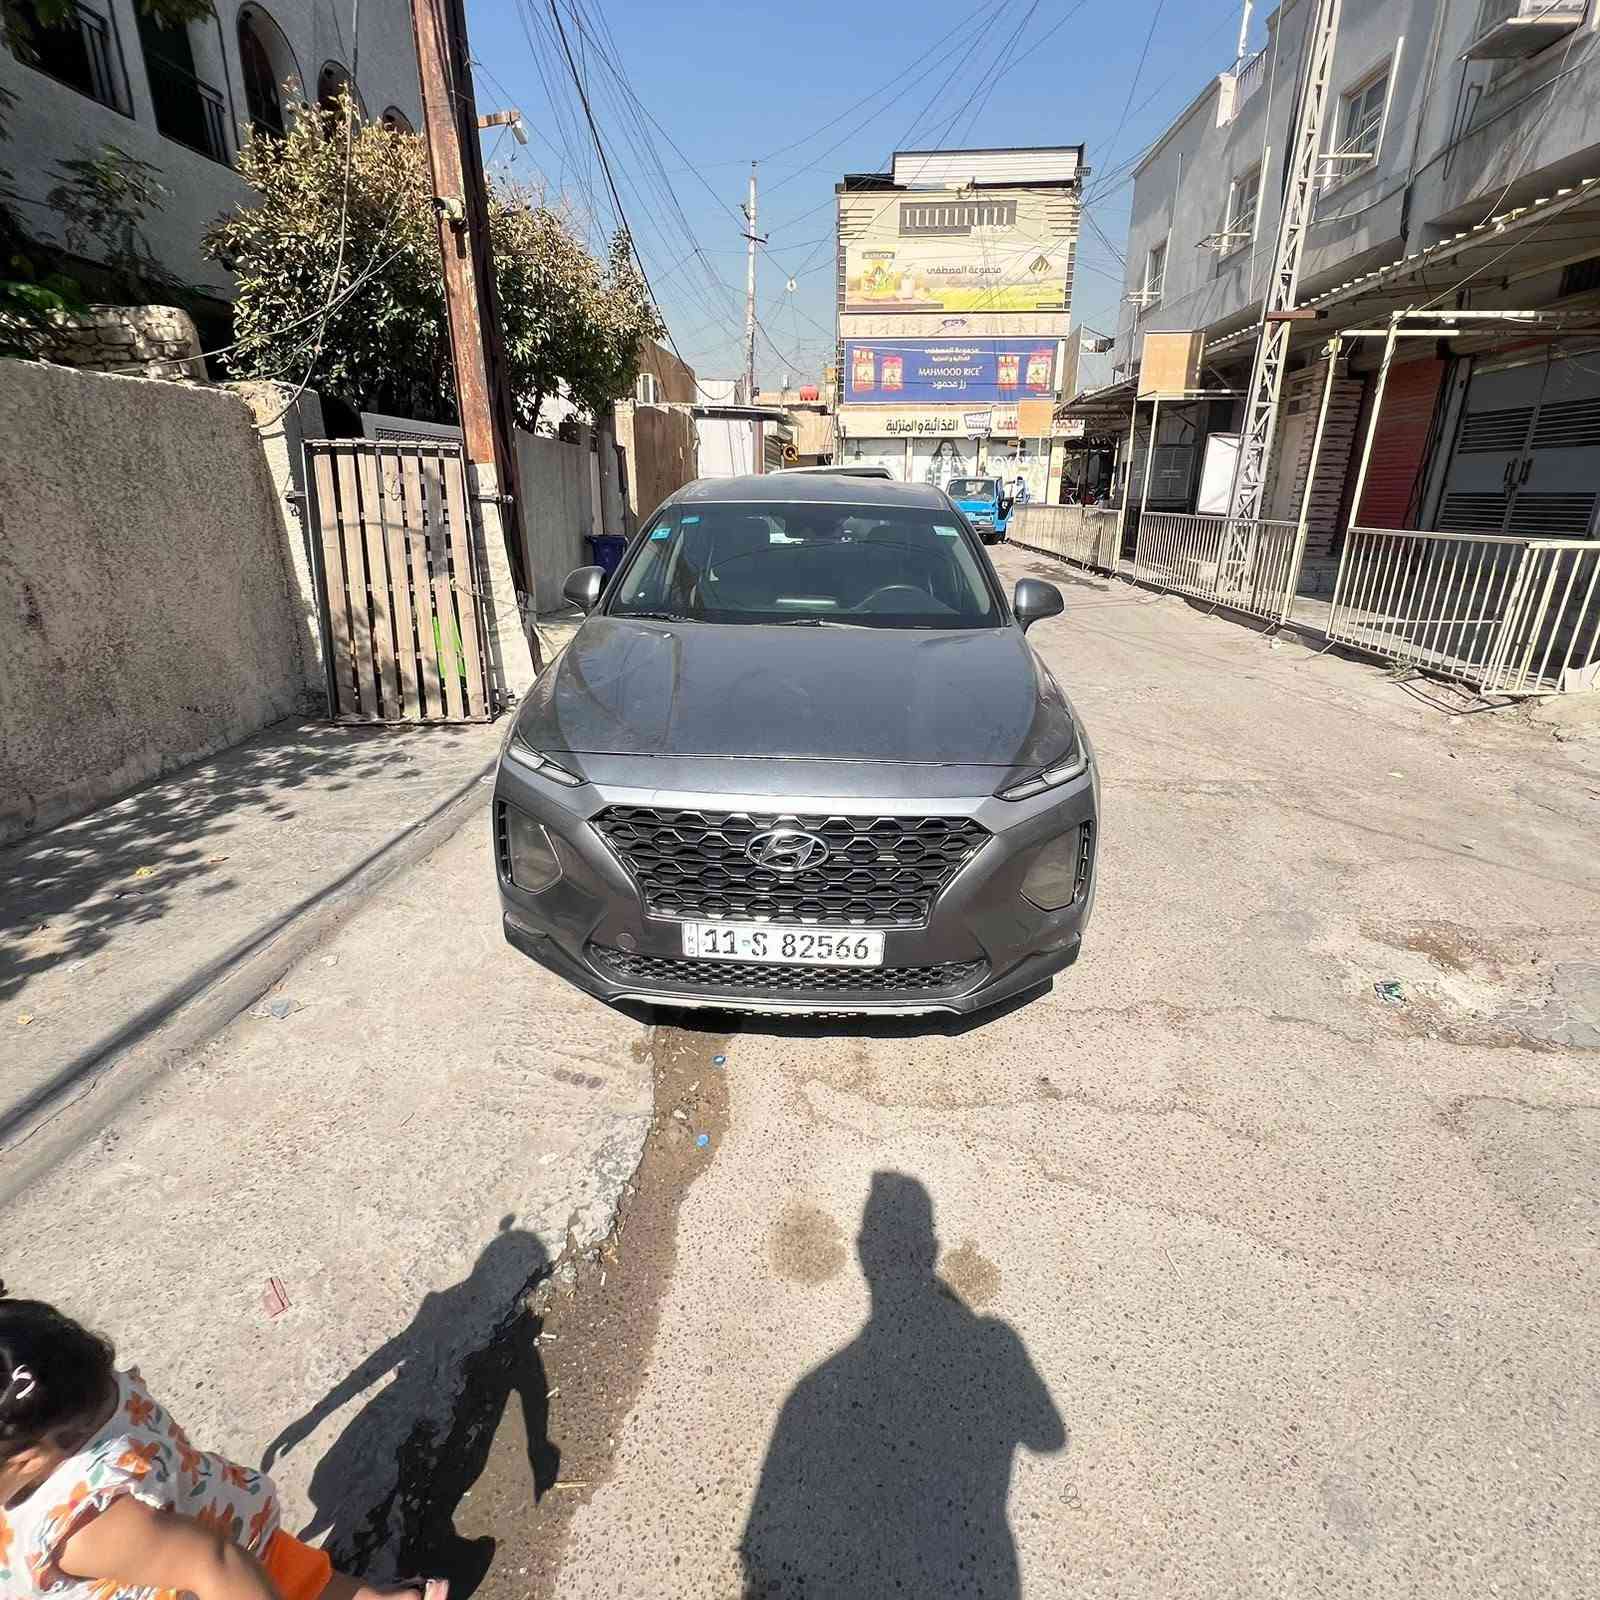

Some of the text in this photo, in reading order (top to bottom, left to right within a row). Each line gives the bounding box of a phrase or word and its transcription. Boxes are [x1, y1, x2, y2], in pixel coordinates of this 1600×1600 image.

[968, 265, 1002, 278] مجموعة
[918, 367, 980, 377] MAHMOOD RICE
[930, 380, 958, 390] محمود
[924, 416, 959, 435] الغذائية
[704, 928, 738, 955] 11
[781, 933, 870, 960] 82566
